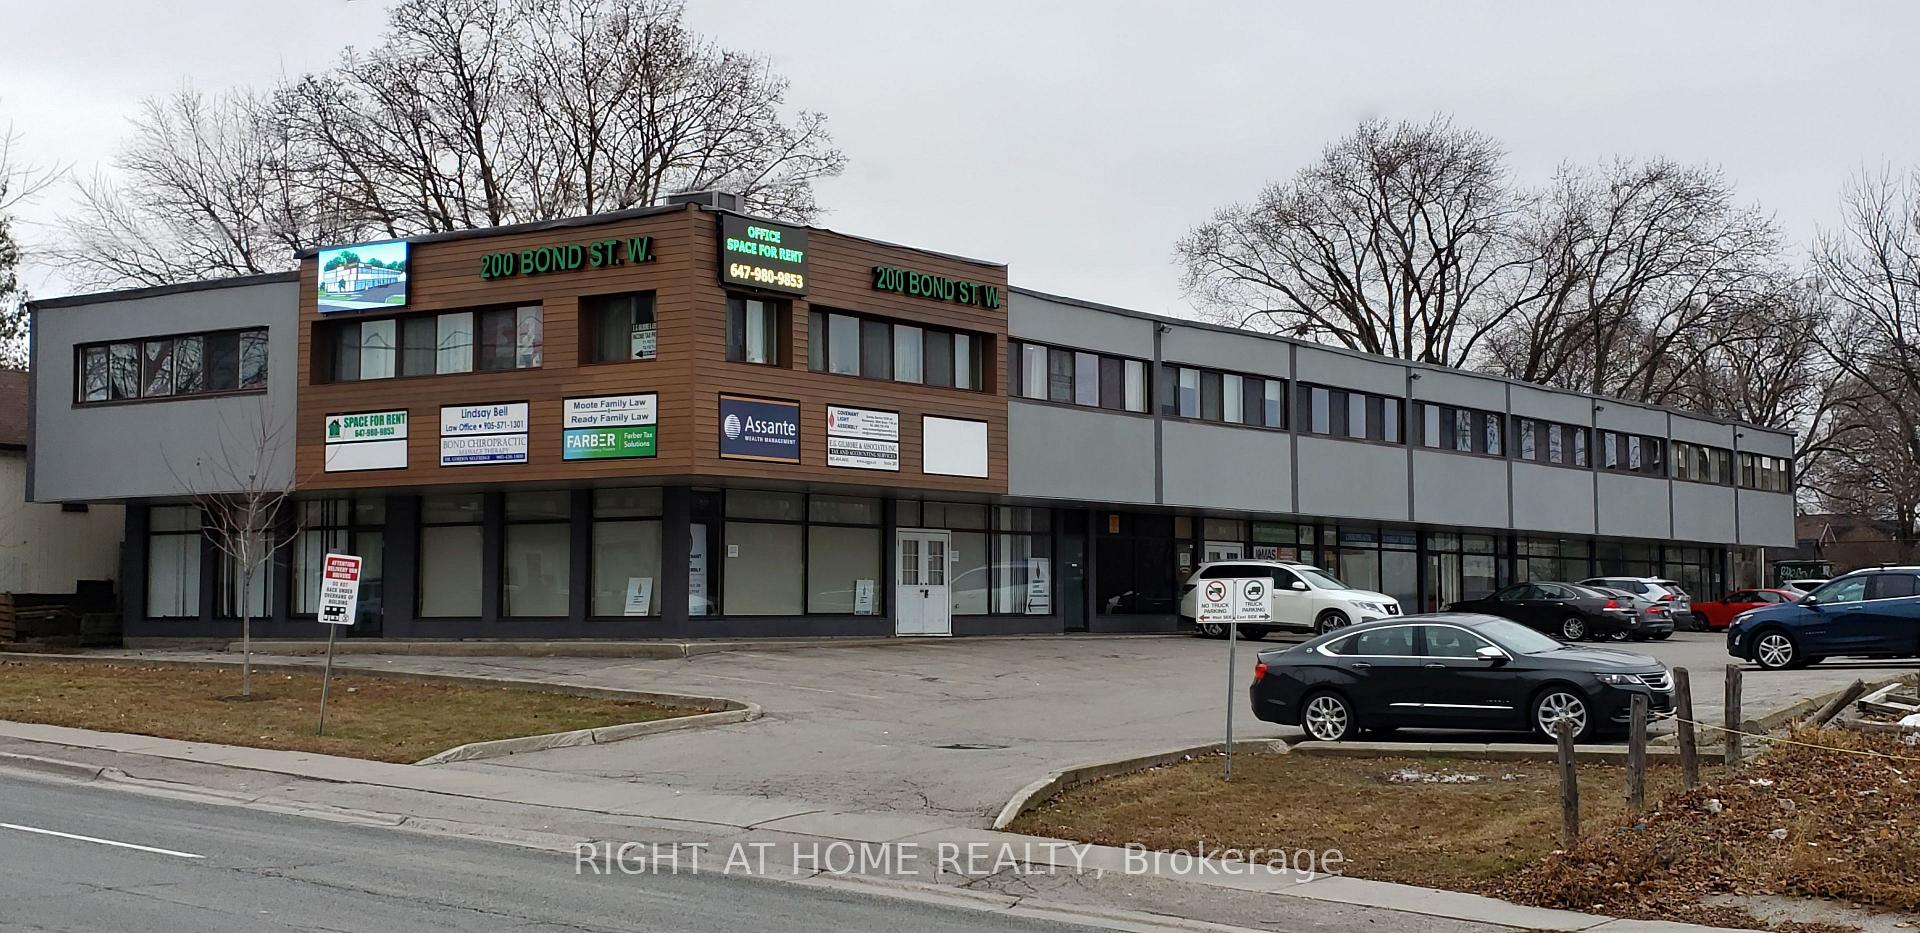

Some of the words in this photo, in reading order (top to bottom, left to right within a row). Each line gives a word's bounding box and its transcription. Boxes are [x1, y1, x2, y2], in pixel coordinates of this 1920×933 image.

[747, 225, 781, 243] OFFICE
[480, 252, 514, 279] 200
[520, 243, 583, 275] BOND
[589, 239, 621, 267] ST.
[626, 236, 653, 262] W.
[726, 238, 757, 255] SPACE
[758, 243, 778, 259] FOR
[779, 247, 803, 263] RENT
[729, 262, 804, 289] 647-980-9853
[876, 266, 904, 292] 200
[909, 271, 955, 300] BOND
[573, 401, 598, 409] Moote
[600, 399, 627, 408] Family
[461, 408, 491, 419] Lindsay
[493, 406, 508, 416] Bell
[571, 415, 598, 424] Ready
[600, 413, 628, 422] Family
[631, 413, 649, 421] Law
[344, 415, 368, 428] SPACE
[370, 414, 384, 426] FOR
[386, 413, 406, 425] RENT
[459, 422, 477, 431] Office
[483, 420, 524, 430] 905-571-1301
[744, 415, 796, 436] Assante
[443, 440, 465, 449] BOND
[467, 437, 526, 448] CHIROPRACTIC
[566, 433, 616, 448] FARBER
[624, 440, 650, 448] Solutions
[764, 437, 796, 445] MANAGEMENT
